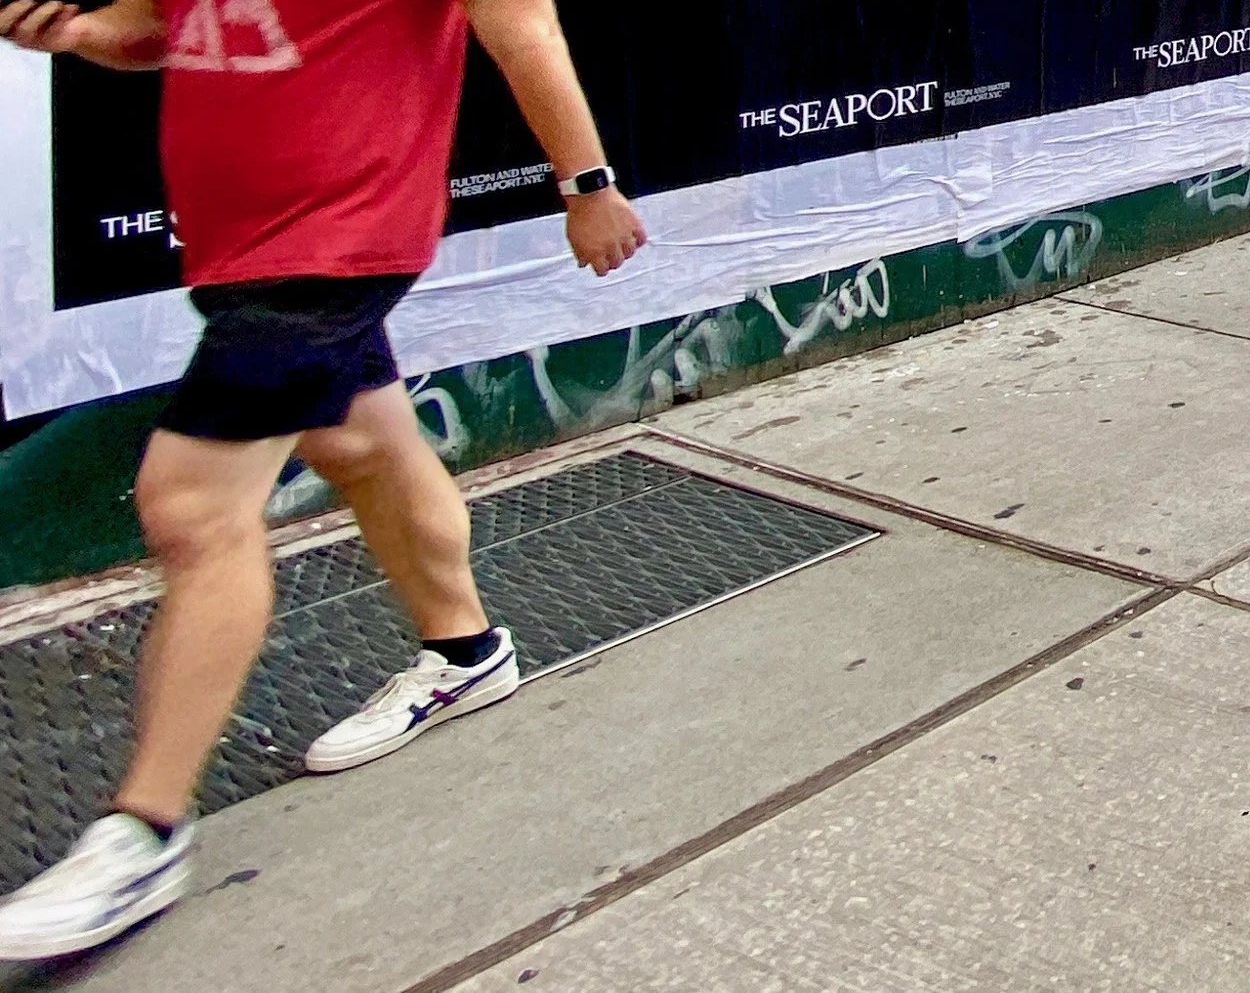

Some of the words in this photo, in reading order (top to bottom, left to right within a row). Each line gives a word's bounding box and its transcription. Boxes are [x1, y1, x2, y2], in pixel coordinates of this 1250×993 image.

[1133, 45, 1159, 60] THE
[739, 108, 777, 129] THE
[779, 81, 938, 138] SEAPORT
[450, 173, 496, 189] FULTON
[496, 168, 520, 181] AND
[520, 162, 553, 176] WATE
[101, 210, 164, 239] THE
